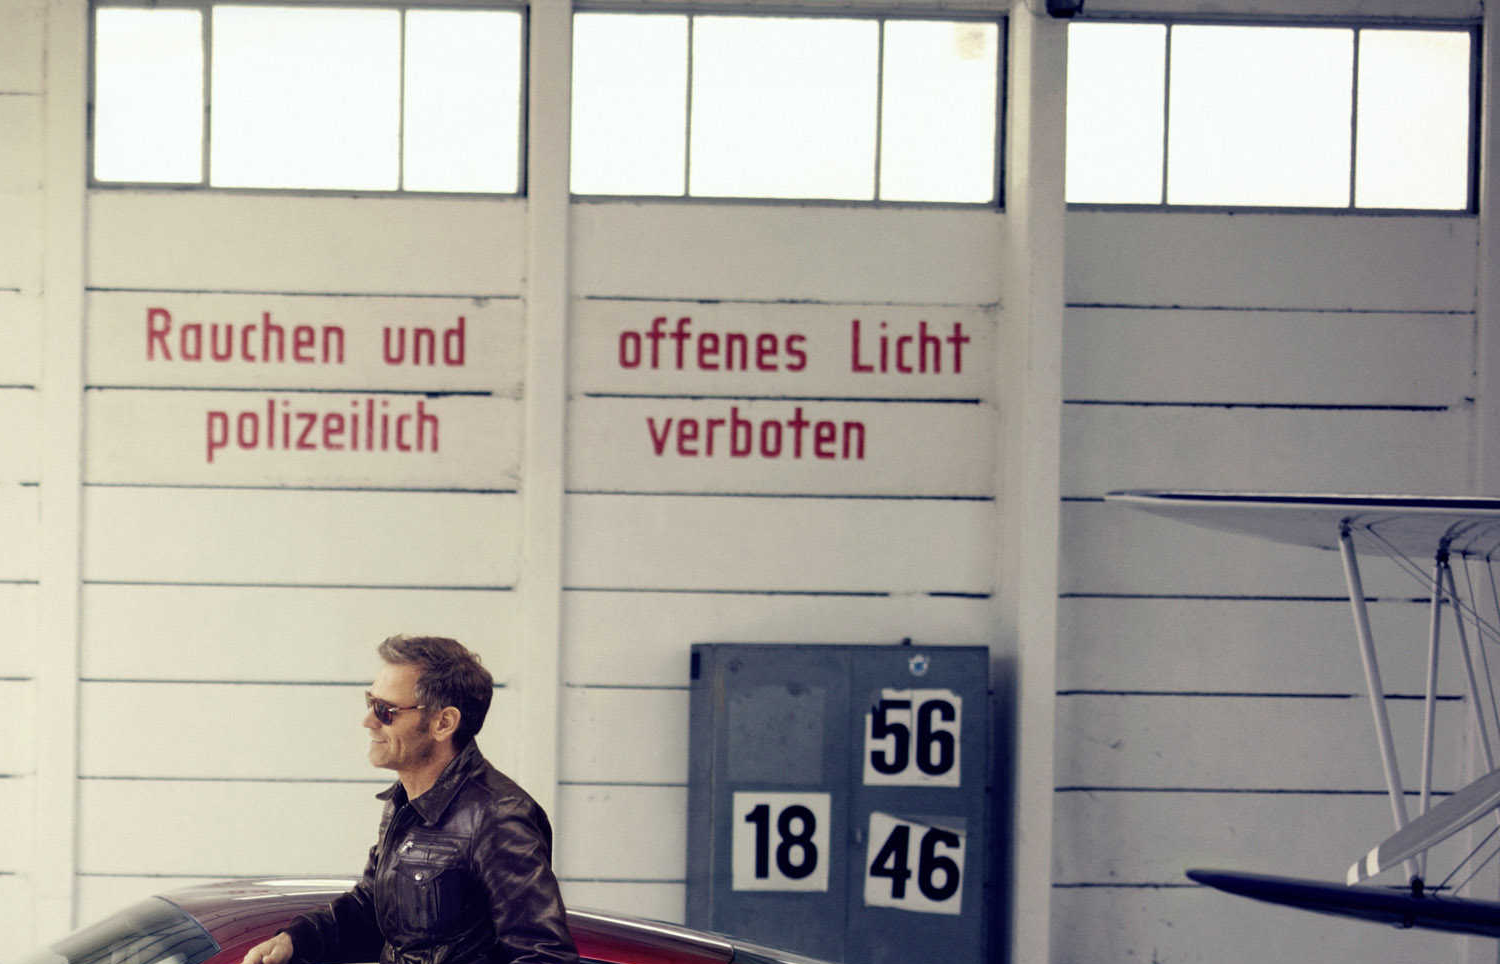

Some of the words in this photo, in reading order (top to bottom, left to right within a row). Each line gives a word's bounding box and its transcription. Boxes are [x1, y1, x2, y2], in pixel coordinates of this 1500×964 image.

[146, 307, 345, 365] Rauchen
[382, 316, 467, 367] und
[618, 315, 808, 372] offenes
[851, 319, 970, 375] Licht
[206, 398, 440, 463] polizeilich
[646, 406, 866, 461] verboten
[870, 699, 955, 776] 56
[745, 804, 818, 880] 18
[869, 824, 961, 902] 46
